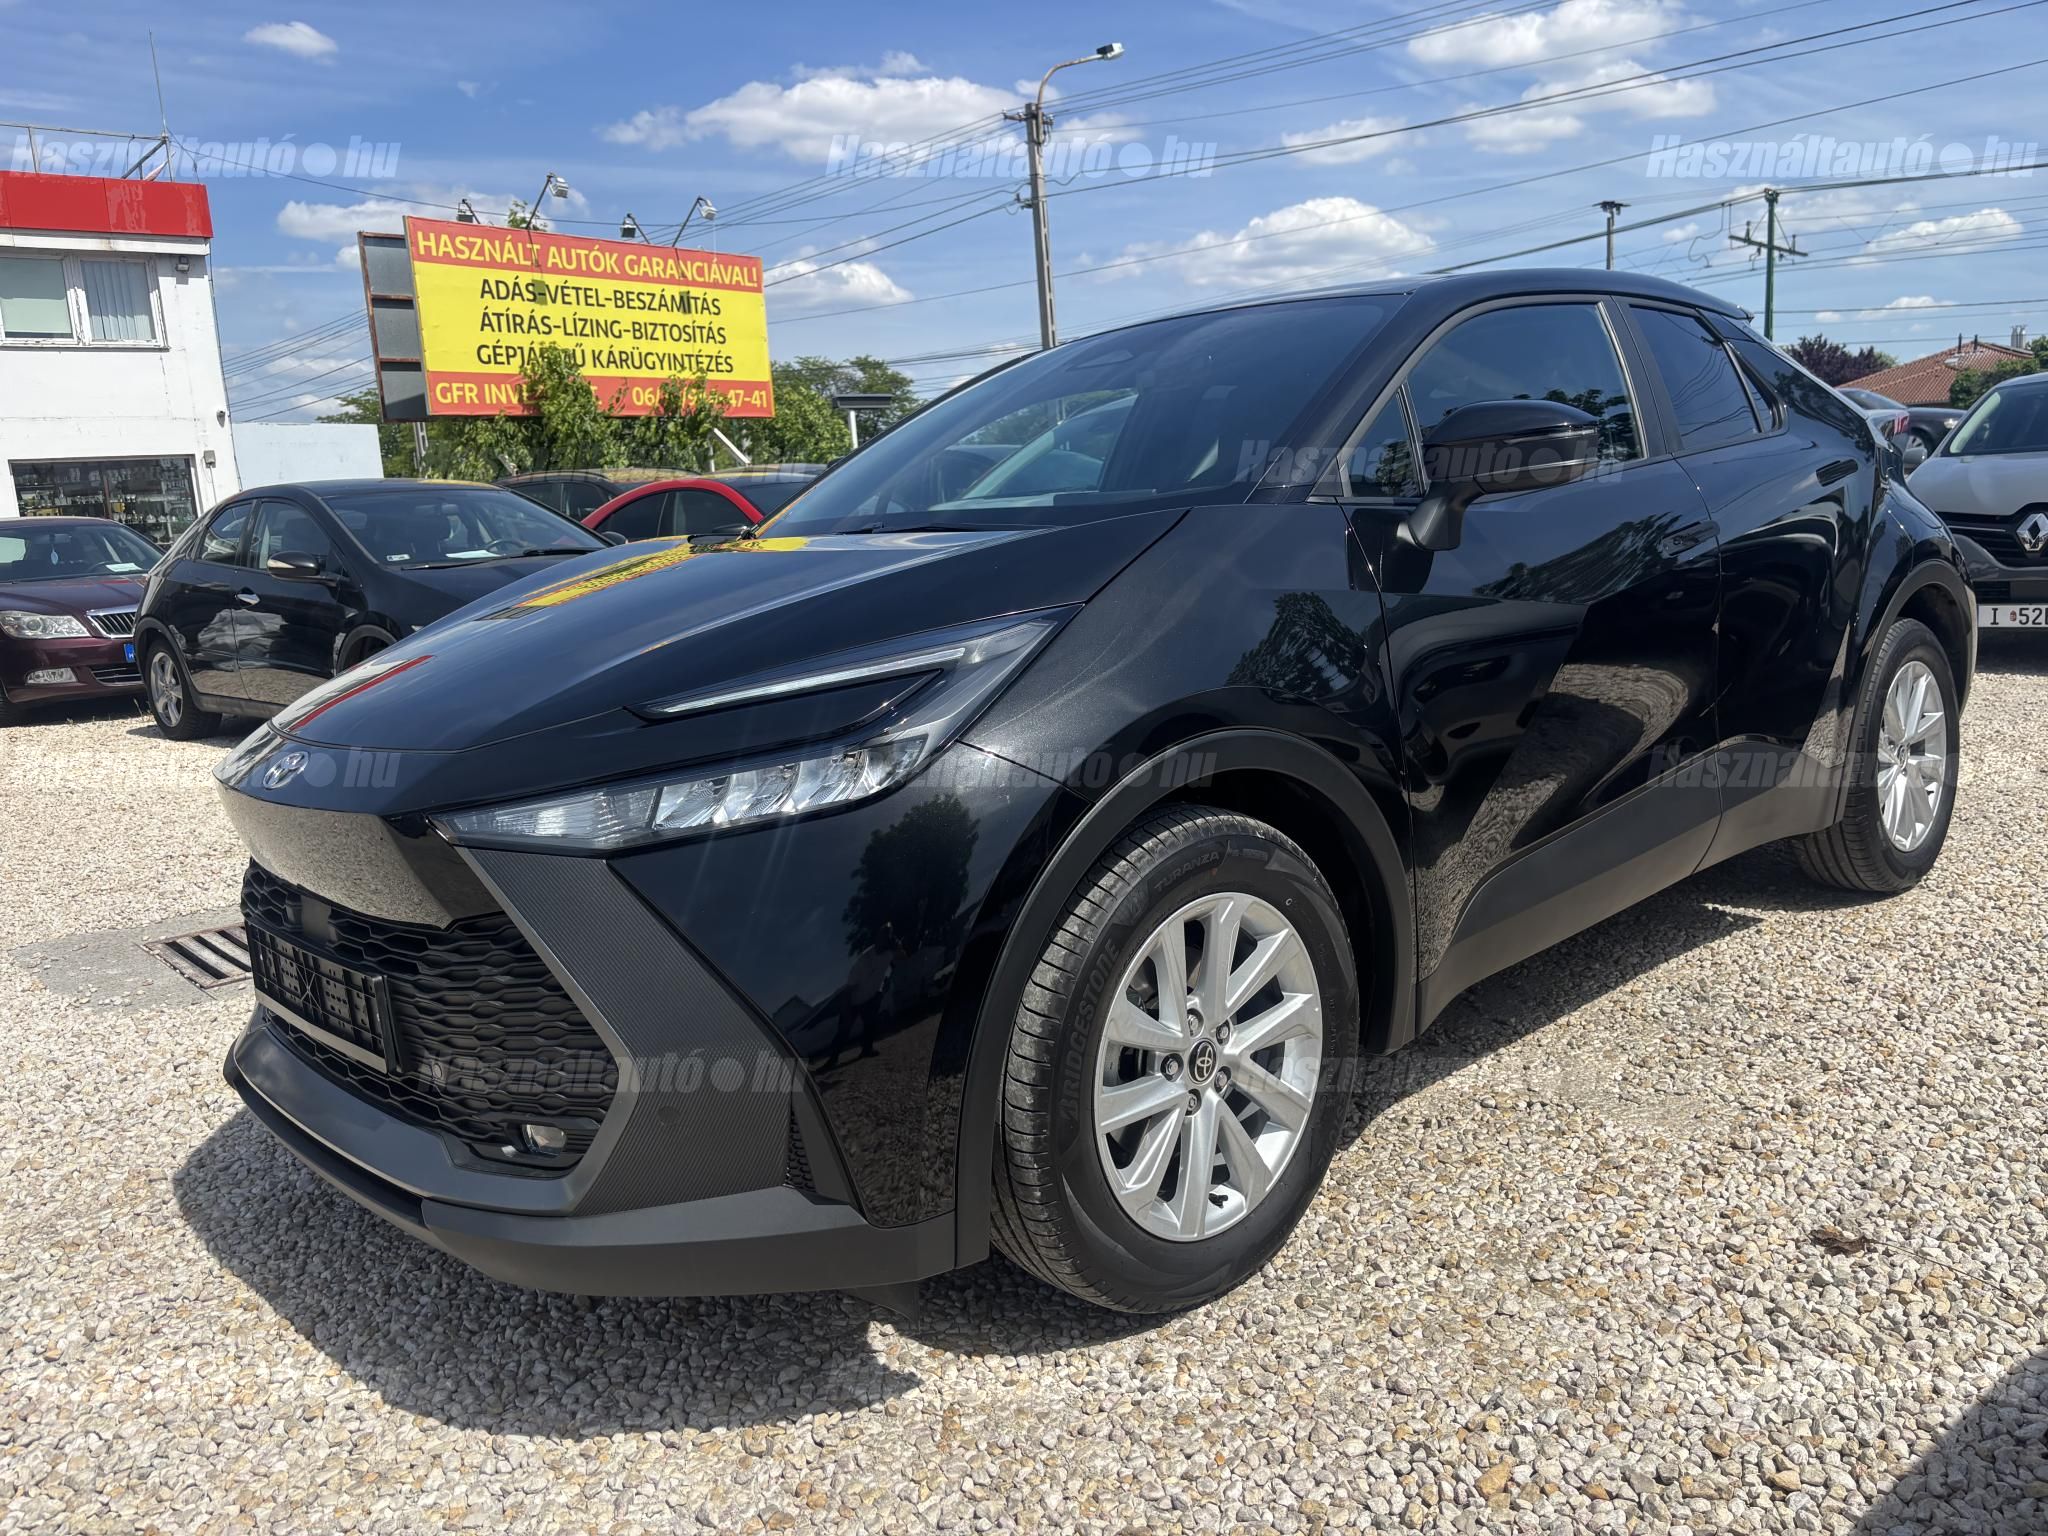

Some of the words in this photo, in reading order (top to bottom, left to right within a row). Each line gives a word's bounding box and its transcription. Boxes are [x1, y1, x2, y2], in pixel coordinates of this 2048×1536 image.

[417, 231, 541, 267] HASZNÁLT
[547, 244, 621, 275] AUTÓK
[624, 253, 758, 288] GARANCIÁVAL!
[480, 275, 721, 316] ADÁS-VÉTEL-BESZÁMÍTÁS
[480, 306, 727, 345] ÁTÍRÁS-LÍZING-BIZTOSÍTÁS
[592, 344, 734, 373] KÁRÜGYINTÉZÉS
[435, 382, 479, 404] GFR
[1153, 850, 1221, 891] TURANZA
[1057, 938, 1120, 1121] BRIDGESTONE
